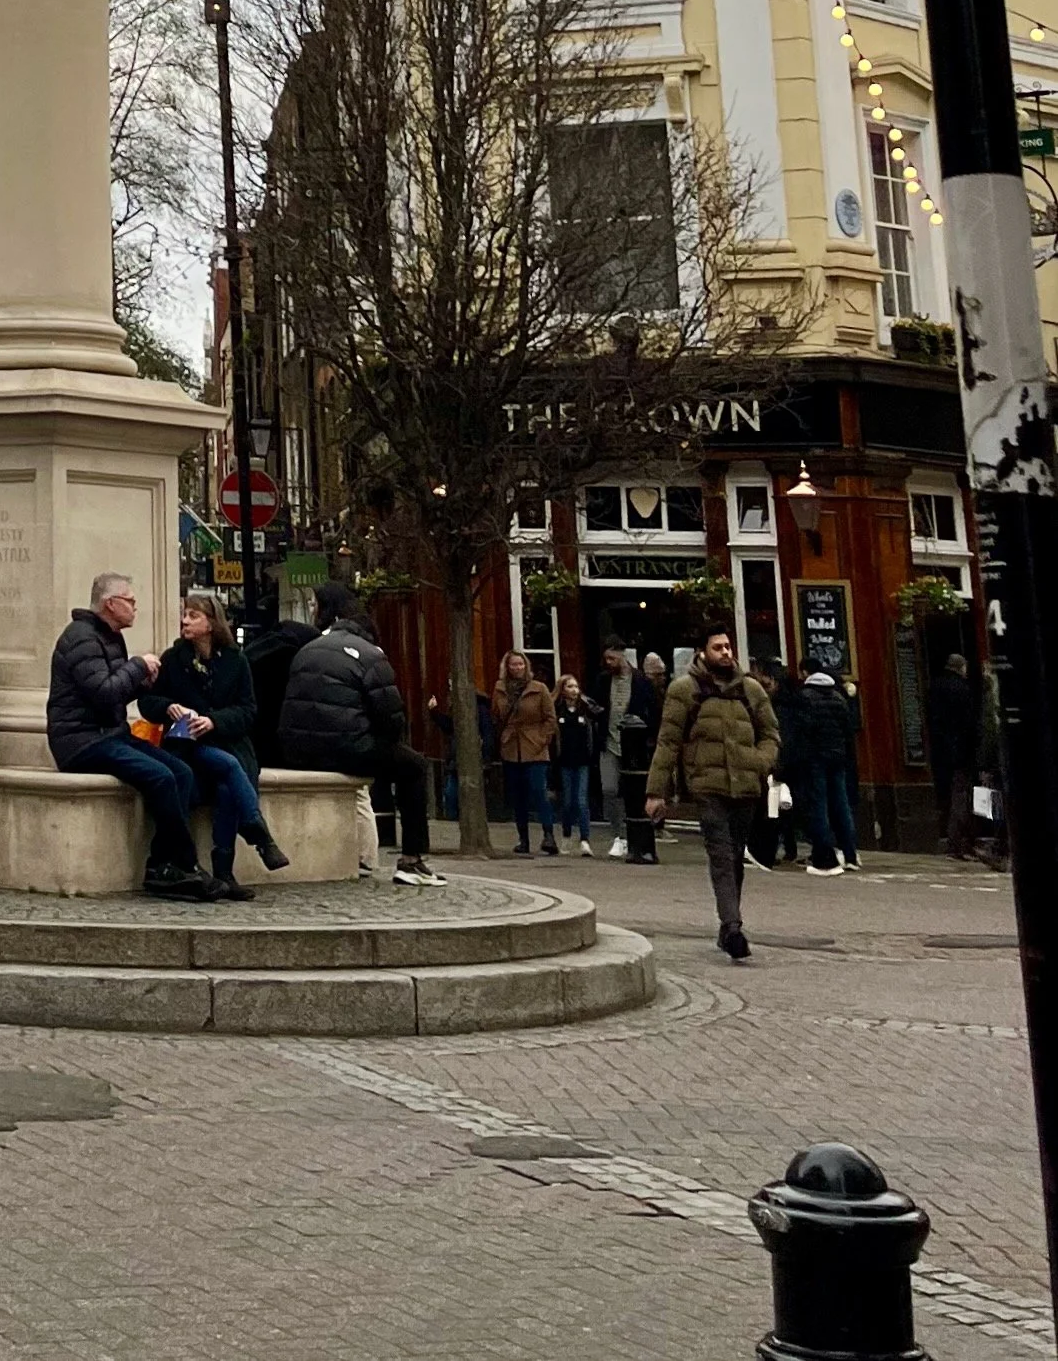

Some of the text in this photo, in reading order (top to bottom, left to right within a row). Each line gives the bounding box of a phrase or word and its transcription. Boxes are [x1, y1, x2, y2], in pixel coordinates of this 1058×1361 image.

[502, 399, 761, 434] THE OWN
[600, 559, 695, 575] ENTRANCE
